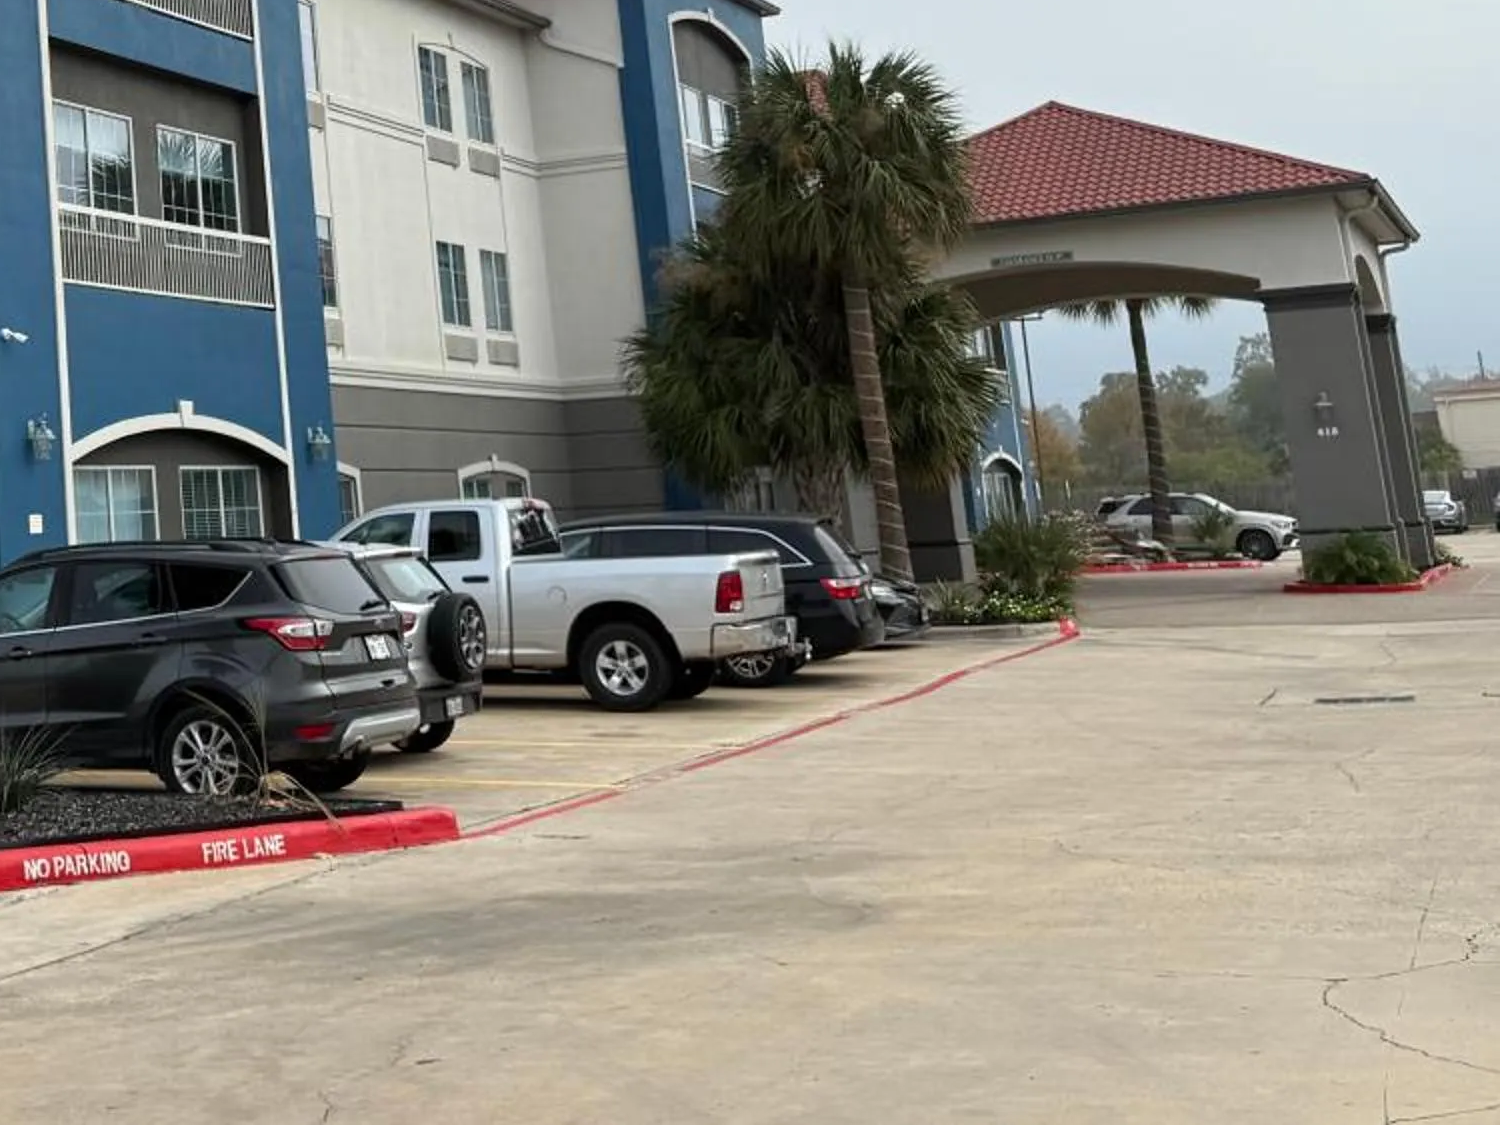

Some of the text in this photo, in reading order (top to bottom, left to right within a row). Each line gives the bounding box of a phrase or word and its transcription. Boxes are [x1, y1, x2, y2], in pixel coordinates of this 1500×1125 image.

[22, 833, 288, 880] NO PARKING FIRE LANE
